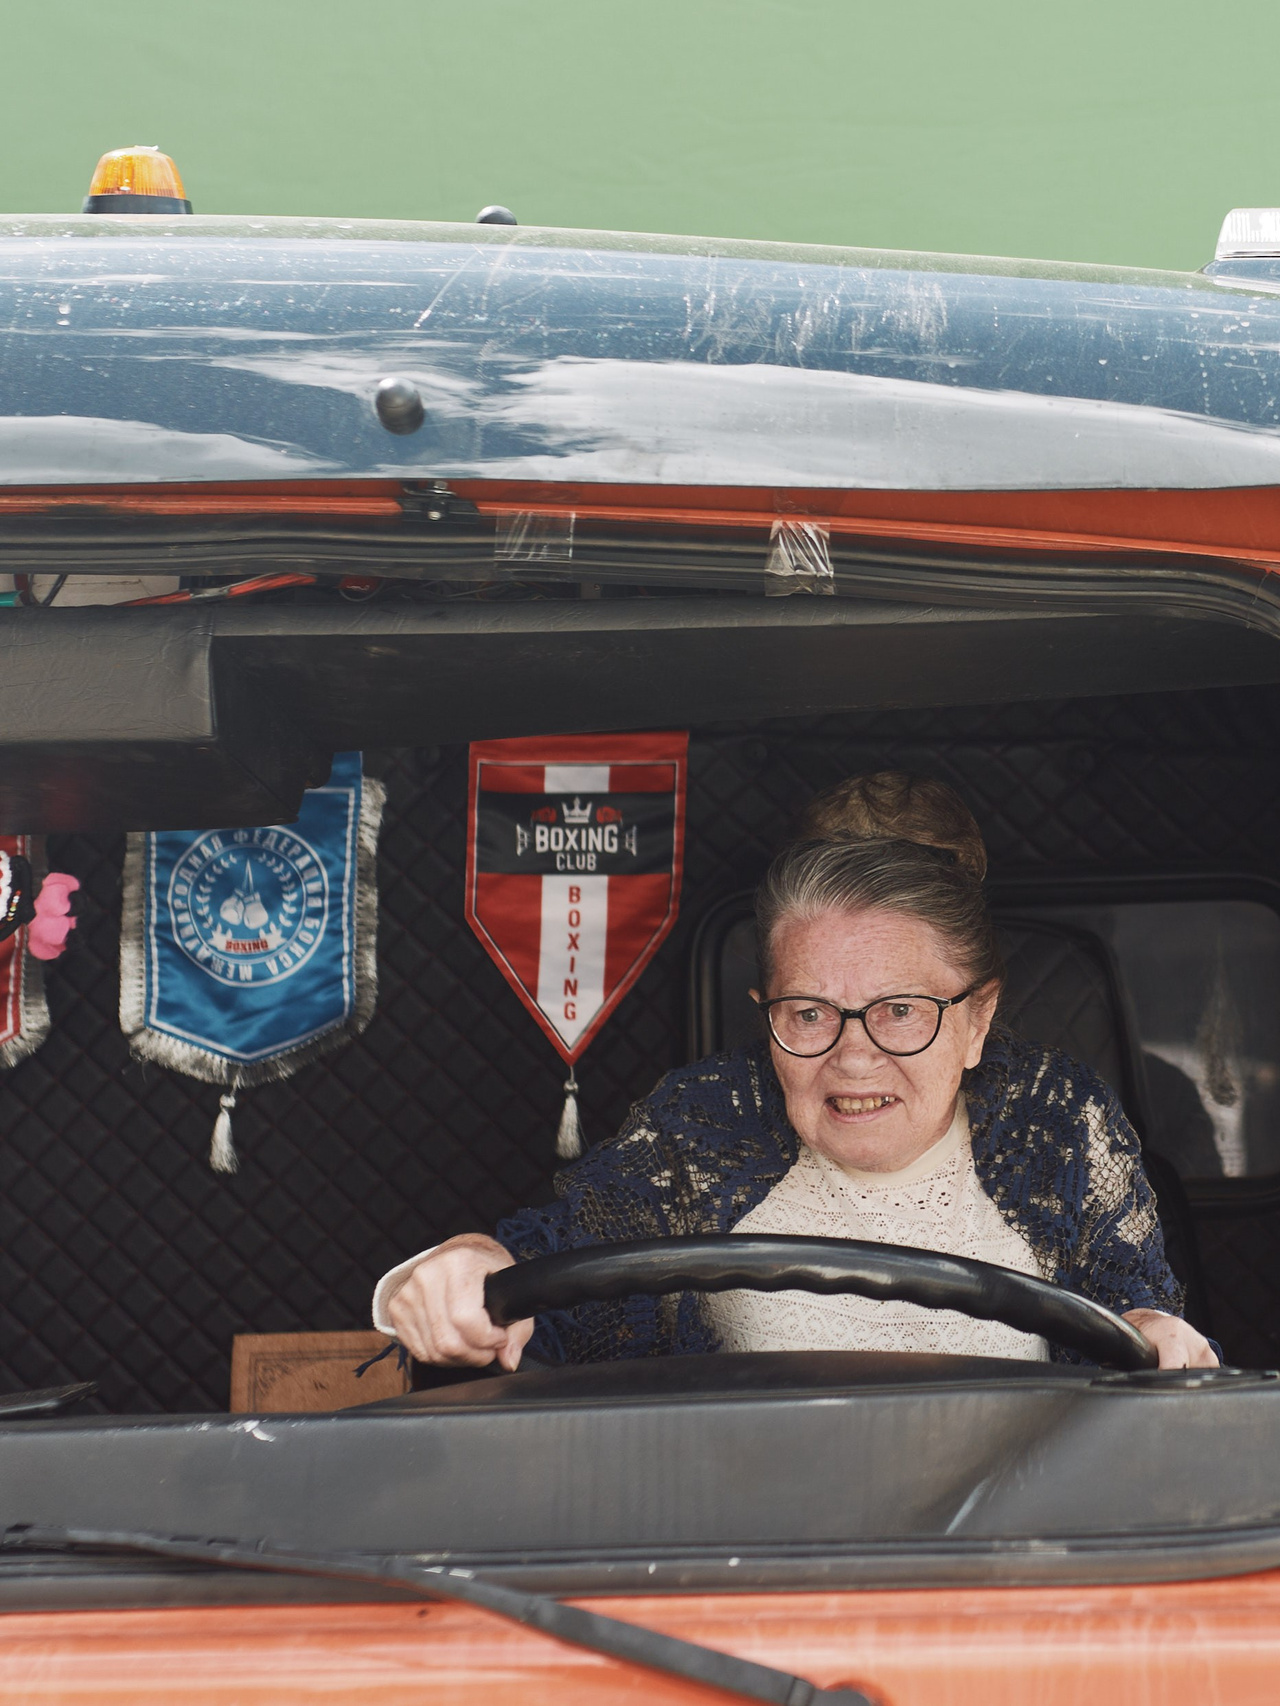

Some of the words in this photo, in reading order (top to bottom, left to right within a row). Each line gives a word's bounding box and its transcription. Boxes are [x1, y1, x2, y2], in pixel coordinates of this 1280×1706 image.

[535, 824, 618, 853] BOXING
[233, 829, 322, 908] ФЕДЕРАЦИЯ
[556, 852, 597, 871] CLUB
[225, 939, 269, 953] BOXING
[265, 917, 320, 976] БОКСА
[564, 885, 581, 1021] BOXING
